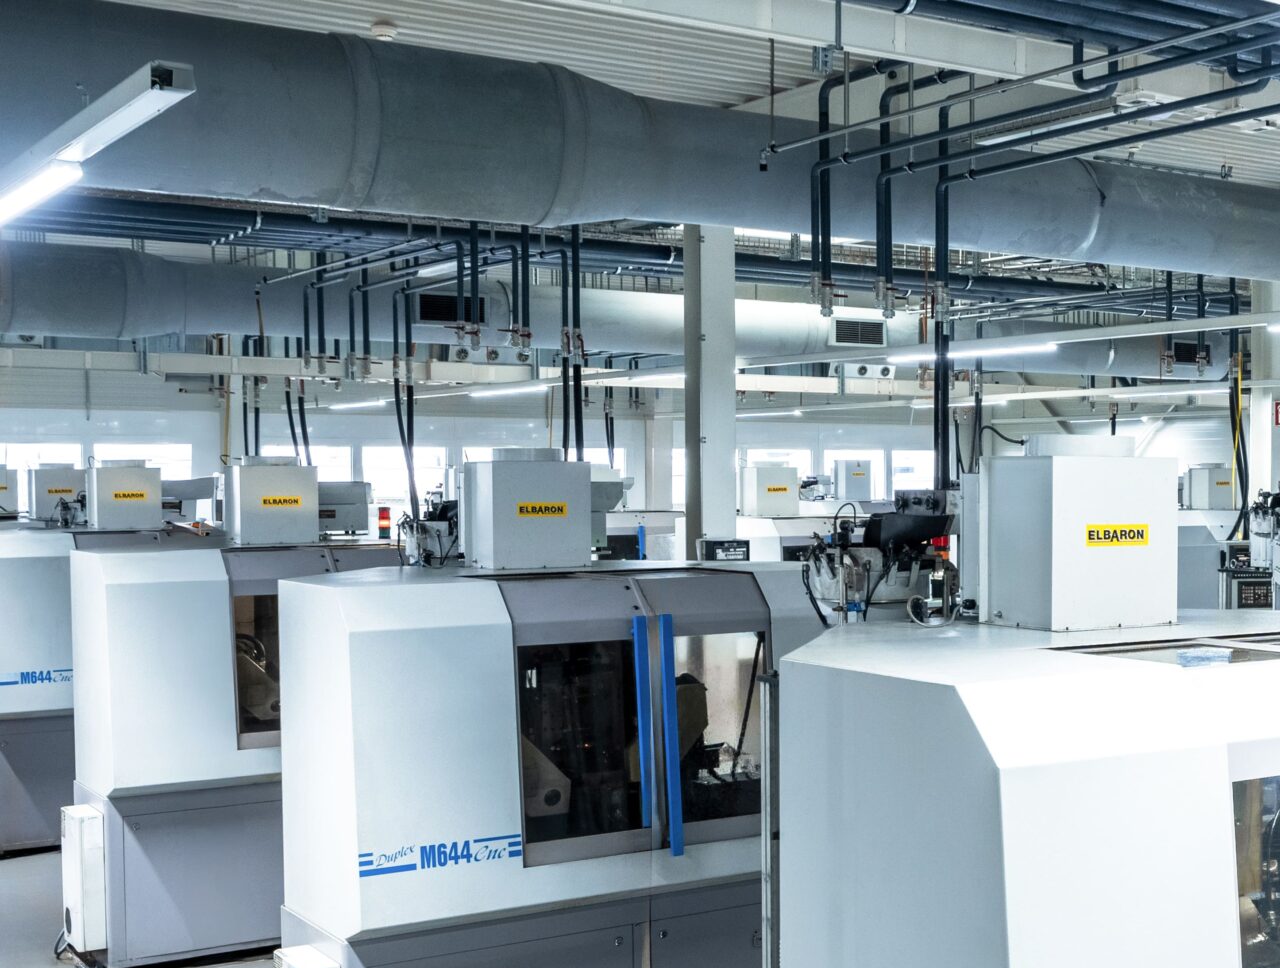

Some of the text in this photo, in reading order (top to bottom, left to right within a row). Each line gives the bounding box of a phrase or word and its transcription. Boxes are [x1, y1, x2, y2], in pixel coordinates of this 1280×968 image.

[519, 506, 564, 514] ELBARON
[1088, 529, 1144, 542] ELBARON
[20, 670, 52, 684] M644
[375, 840, 507, 869] Duplex M644 Cnc
